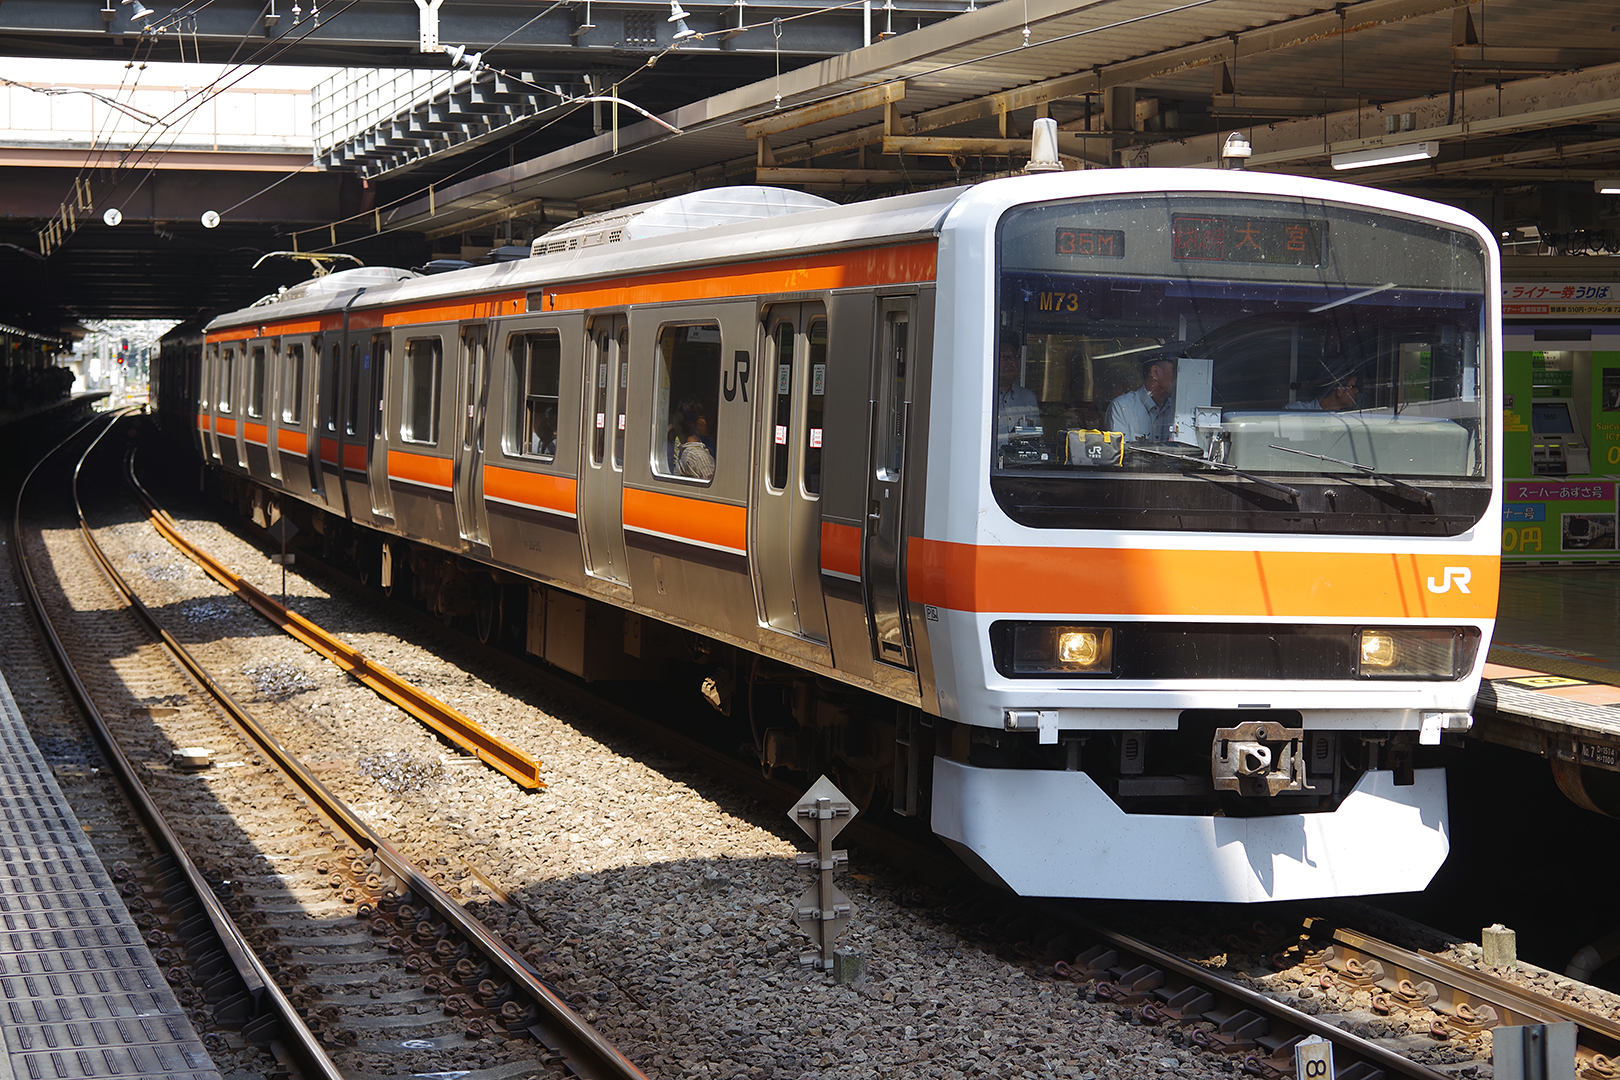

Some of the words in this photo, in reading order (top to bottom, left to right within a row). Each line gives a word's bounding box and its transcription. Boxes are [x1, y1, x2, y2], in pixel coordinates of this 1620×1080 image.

[1059, 231, 1114, 256] 35M
[1235, 222, 1308, 251] 大宮
[1040, 291, 1079, 312] M73
[723, 350, 750, 402] JR
[1088, 446, 1102, 454] JR
[1518, 485, 1603, 499] スーパーあずさ号
[1427, 566, 1472, 594] JR
[1590, 746, 1595, 758] 7
[1305, 1059, 1326, 1078] 8
